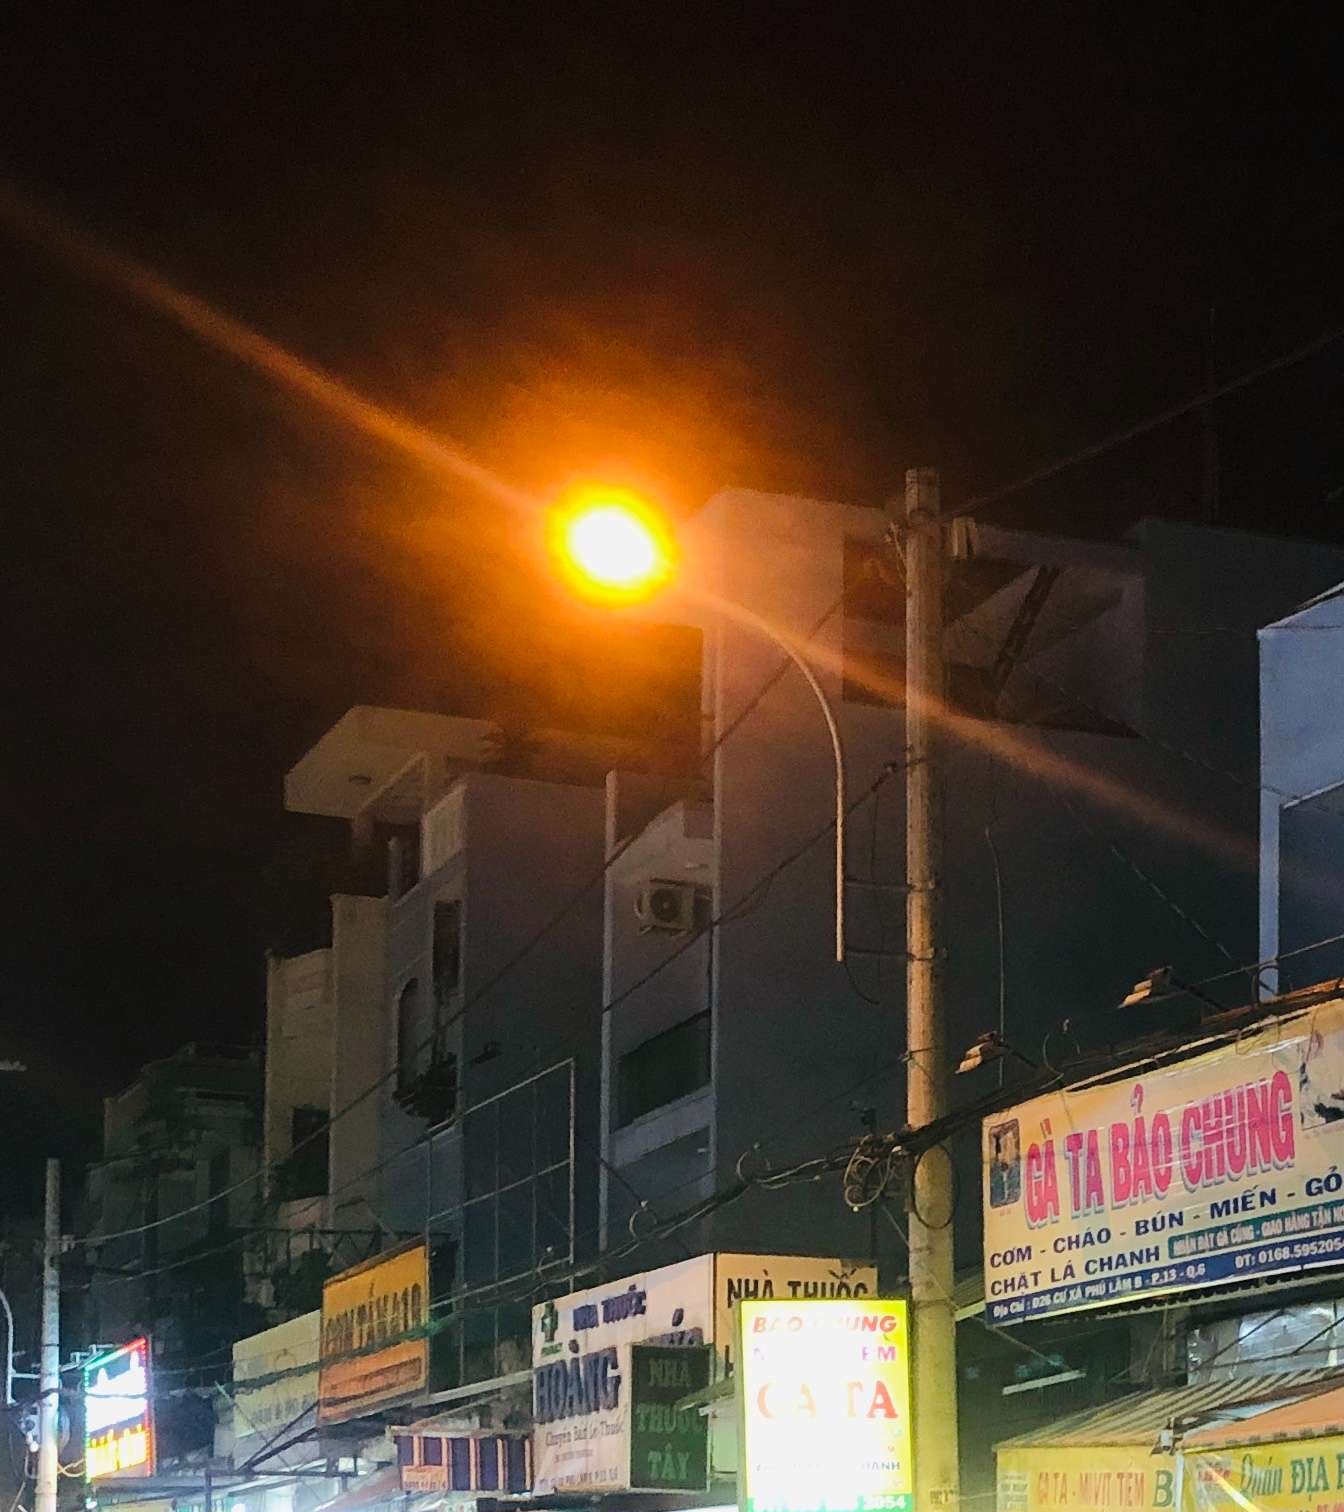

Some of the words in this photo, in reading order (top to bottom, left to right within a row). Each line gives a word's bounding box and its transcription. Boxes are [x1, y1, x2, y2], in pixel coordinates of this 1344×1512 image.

[1025, 1117, 1060, 1226] GÀ
[1064, 1129, 1105, 1214] TA
[1111, 1083, 1173, 1204] BẢO
[1181, 1070, 1296, 1187] CHUNG
[990, 1244, 1032, 1269] CƠM
[1052, 1226, 1111, 1254] CHÁO
[1134, 1208, 1184, 1237] BÚN
[1209, 1184, 1277, 1220] MIẾN
[1050, 1260, 1076, 1283] LÁ
[1084, 1245, 1160, 1276] CHANH
[727, 1269, 775, 1307] NHÀ
[1152, 1469, 1175, 1508] B
[1290, 1456, 1330, 1501] ĐỊA
